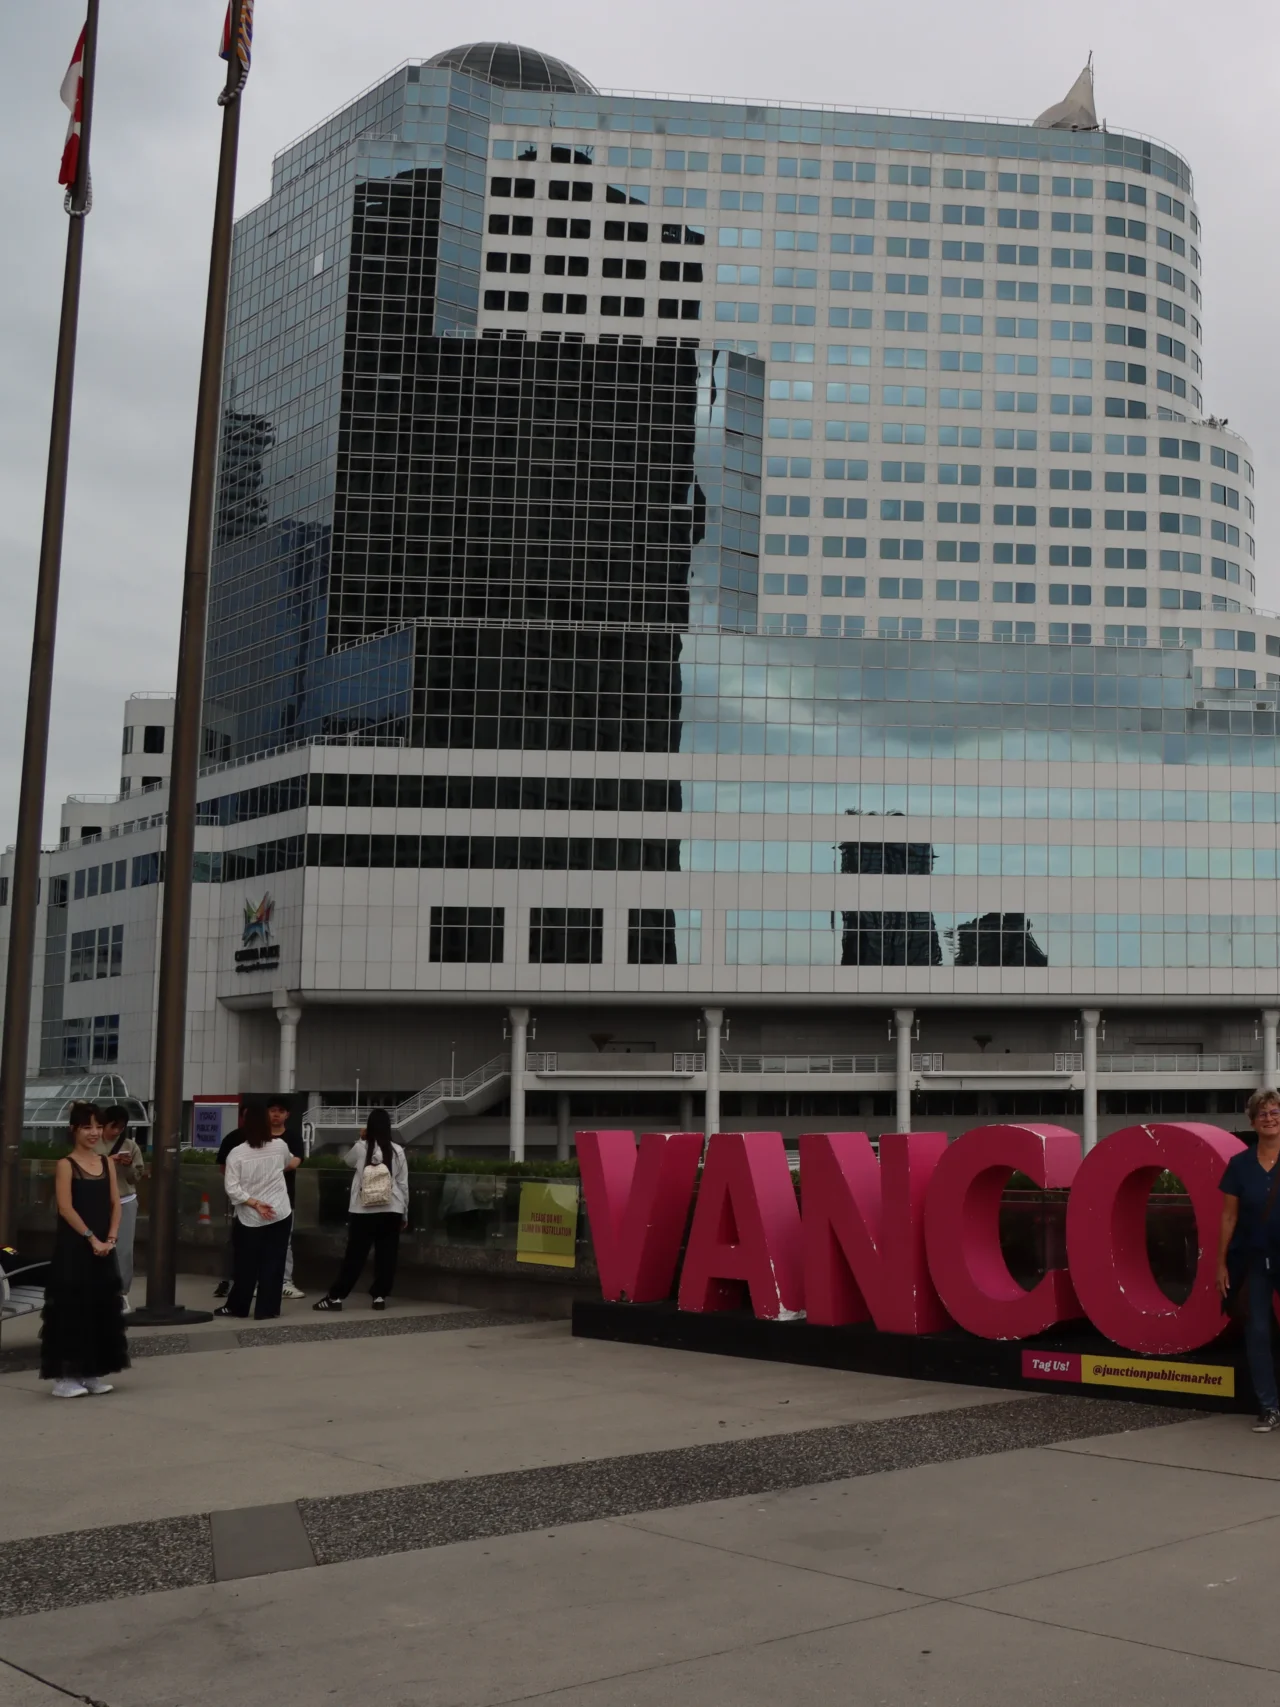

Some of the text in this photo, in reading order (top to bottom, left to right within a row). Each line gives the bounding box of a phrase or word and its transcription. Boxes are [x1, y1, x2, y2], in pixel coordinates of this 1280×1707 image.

[542, 1225, 571, 1236] INSTALLATION
[1032, 1359, 1070, 1372] Tag Us!
[1092, 1364, 1223, 1386] @junctionpublicmarket
